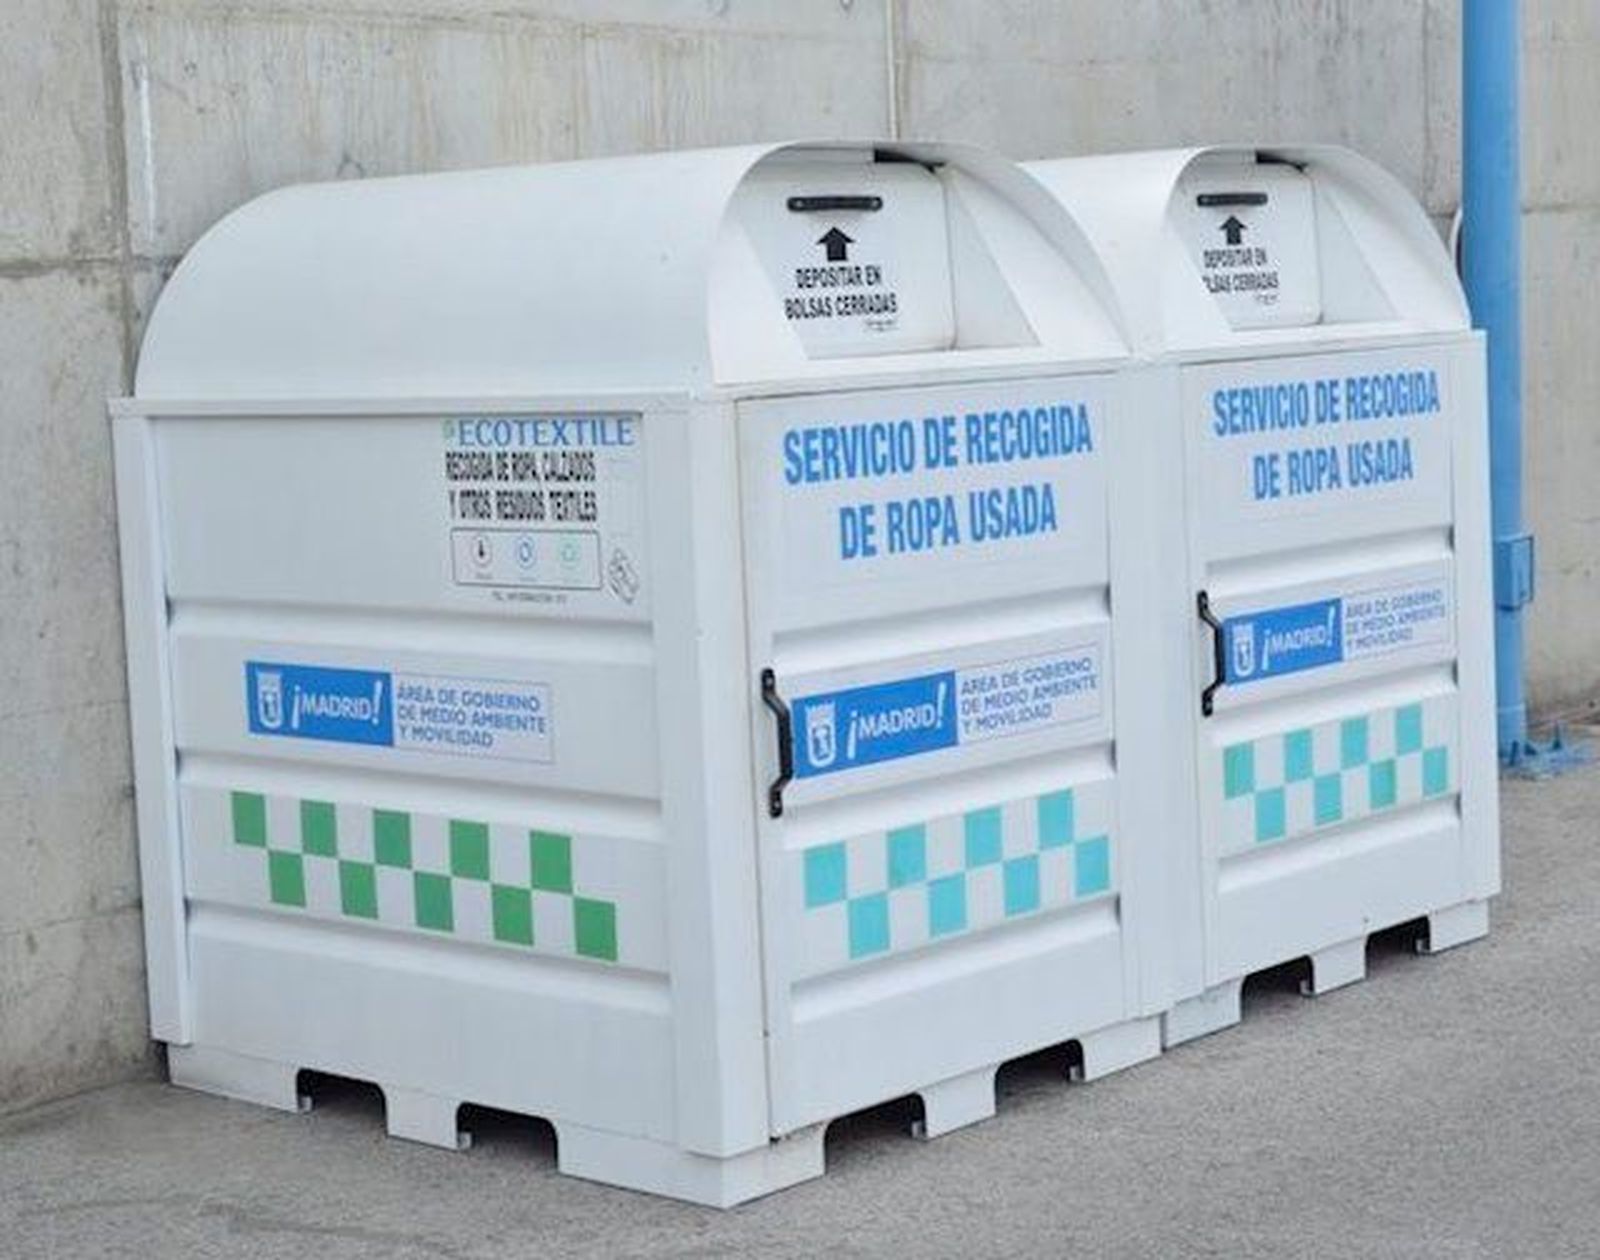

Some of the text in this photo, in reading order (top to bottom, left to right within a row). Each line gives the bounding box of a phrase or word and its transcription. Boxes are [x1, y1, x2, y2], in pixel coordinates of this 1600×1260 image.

[796, 265, 882, 289] DEPOSITAR EN
[784, 293, 898, 320] BOLSAS CERRADAS
[1213, 371, 1440, 436] SERVICIO DE RECOGIDA
[459, 418, 635, 446] ECOTEXTILE
[784, 404, 1093, 485] SERVICIO DE RECOGIDA
[1254, 438, 1413, 500] DE ROPA USADA
[840, 483, 1057, 560] DE ROPA USADA
[1001, 671, 1019, 688] DE
[1022, 657, 1092, 684] GOBIERNO
[438, 689, 458, 705] DE
[462, 691, 541, 712] GOBIERNO
[961, 675, 1096, 715] DE MEDIO AMBIENTE
[399, 705, 546, 733] DE MEDIO AMBIENTE
[961, 703, 1052, 734] Y MOVILIDAD
[399, 725, 494, 747] Y MOVILIDAD
